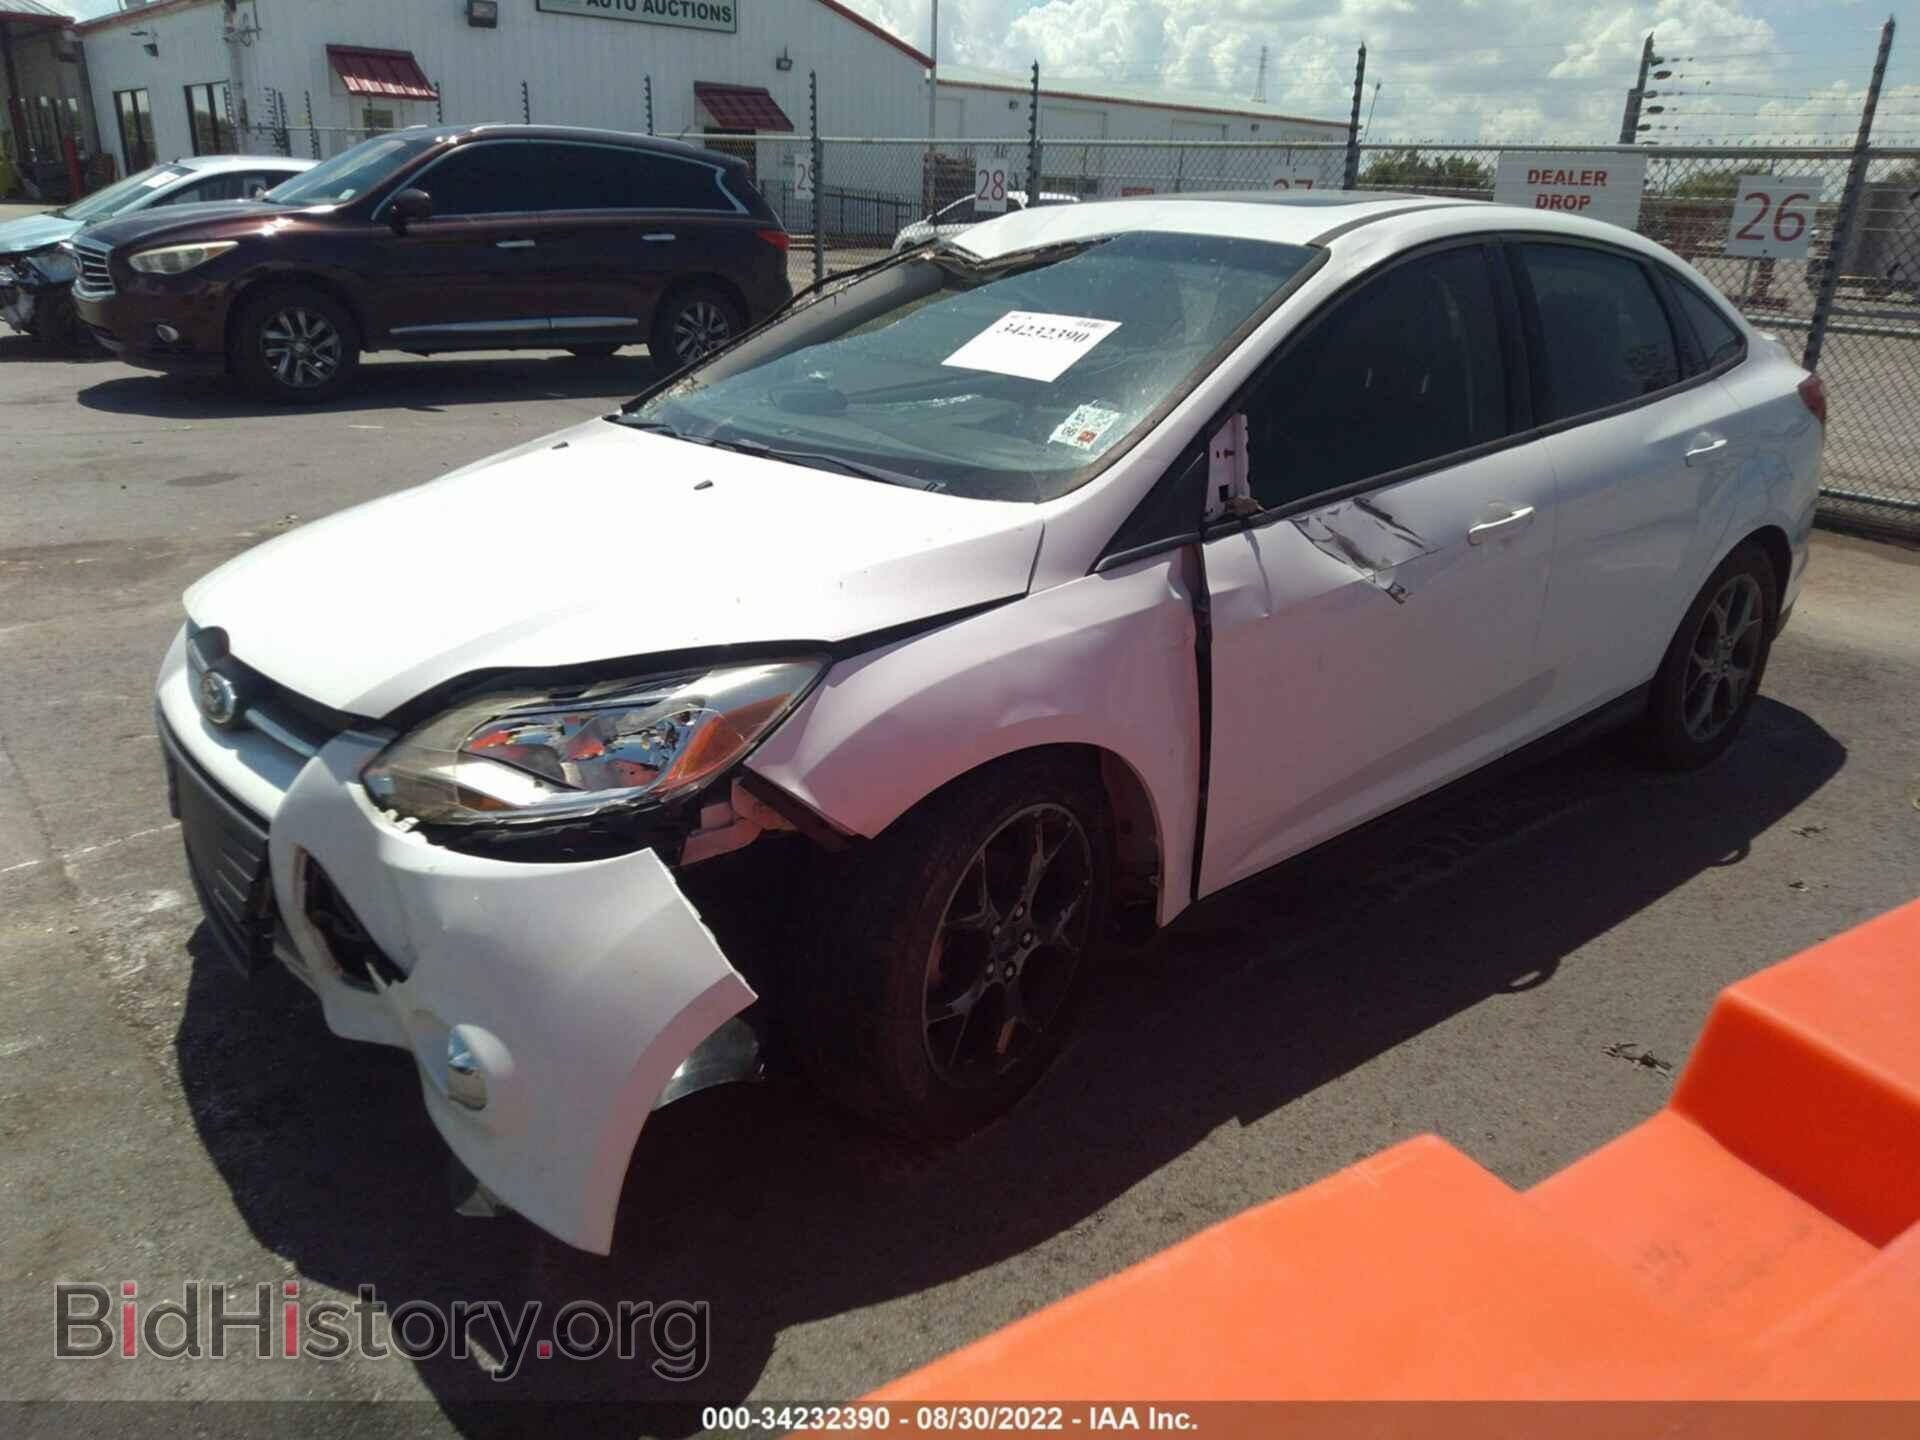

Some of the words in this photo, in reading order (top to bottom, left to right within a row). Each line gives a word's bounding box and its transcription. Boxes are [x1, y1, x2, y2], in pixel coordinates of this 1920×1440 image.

[642, 0, 732, 23] AUCTIONS
[977, 169, 1004, 201] 28
[1527, 169, 1608, 187] DEALER
[1535, 193, 1592, 211] DROP
[1735, 192, 1811, 242] 26
